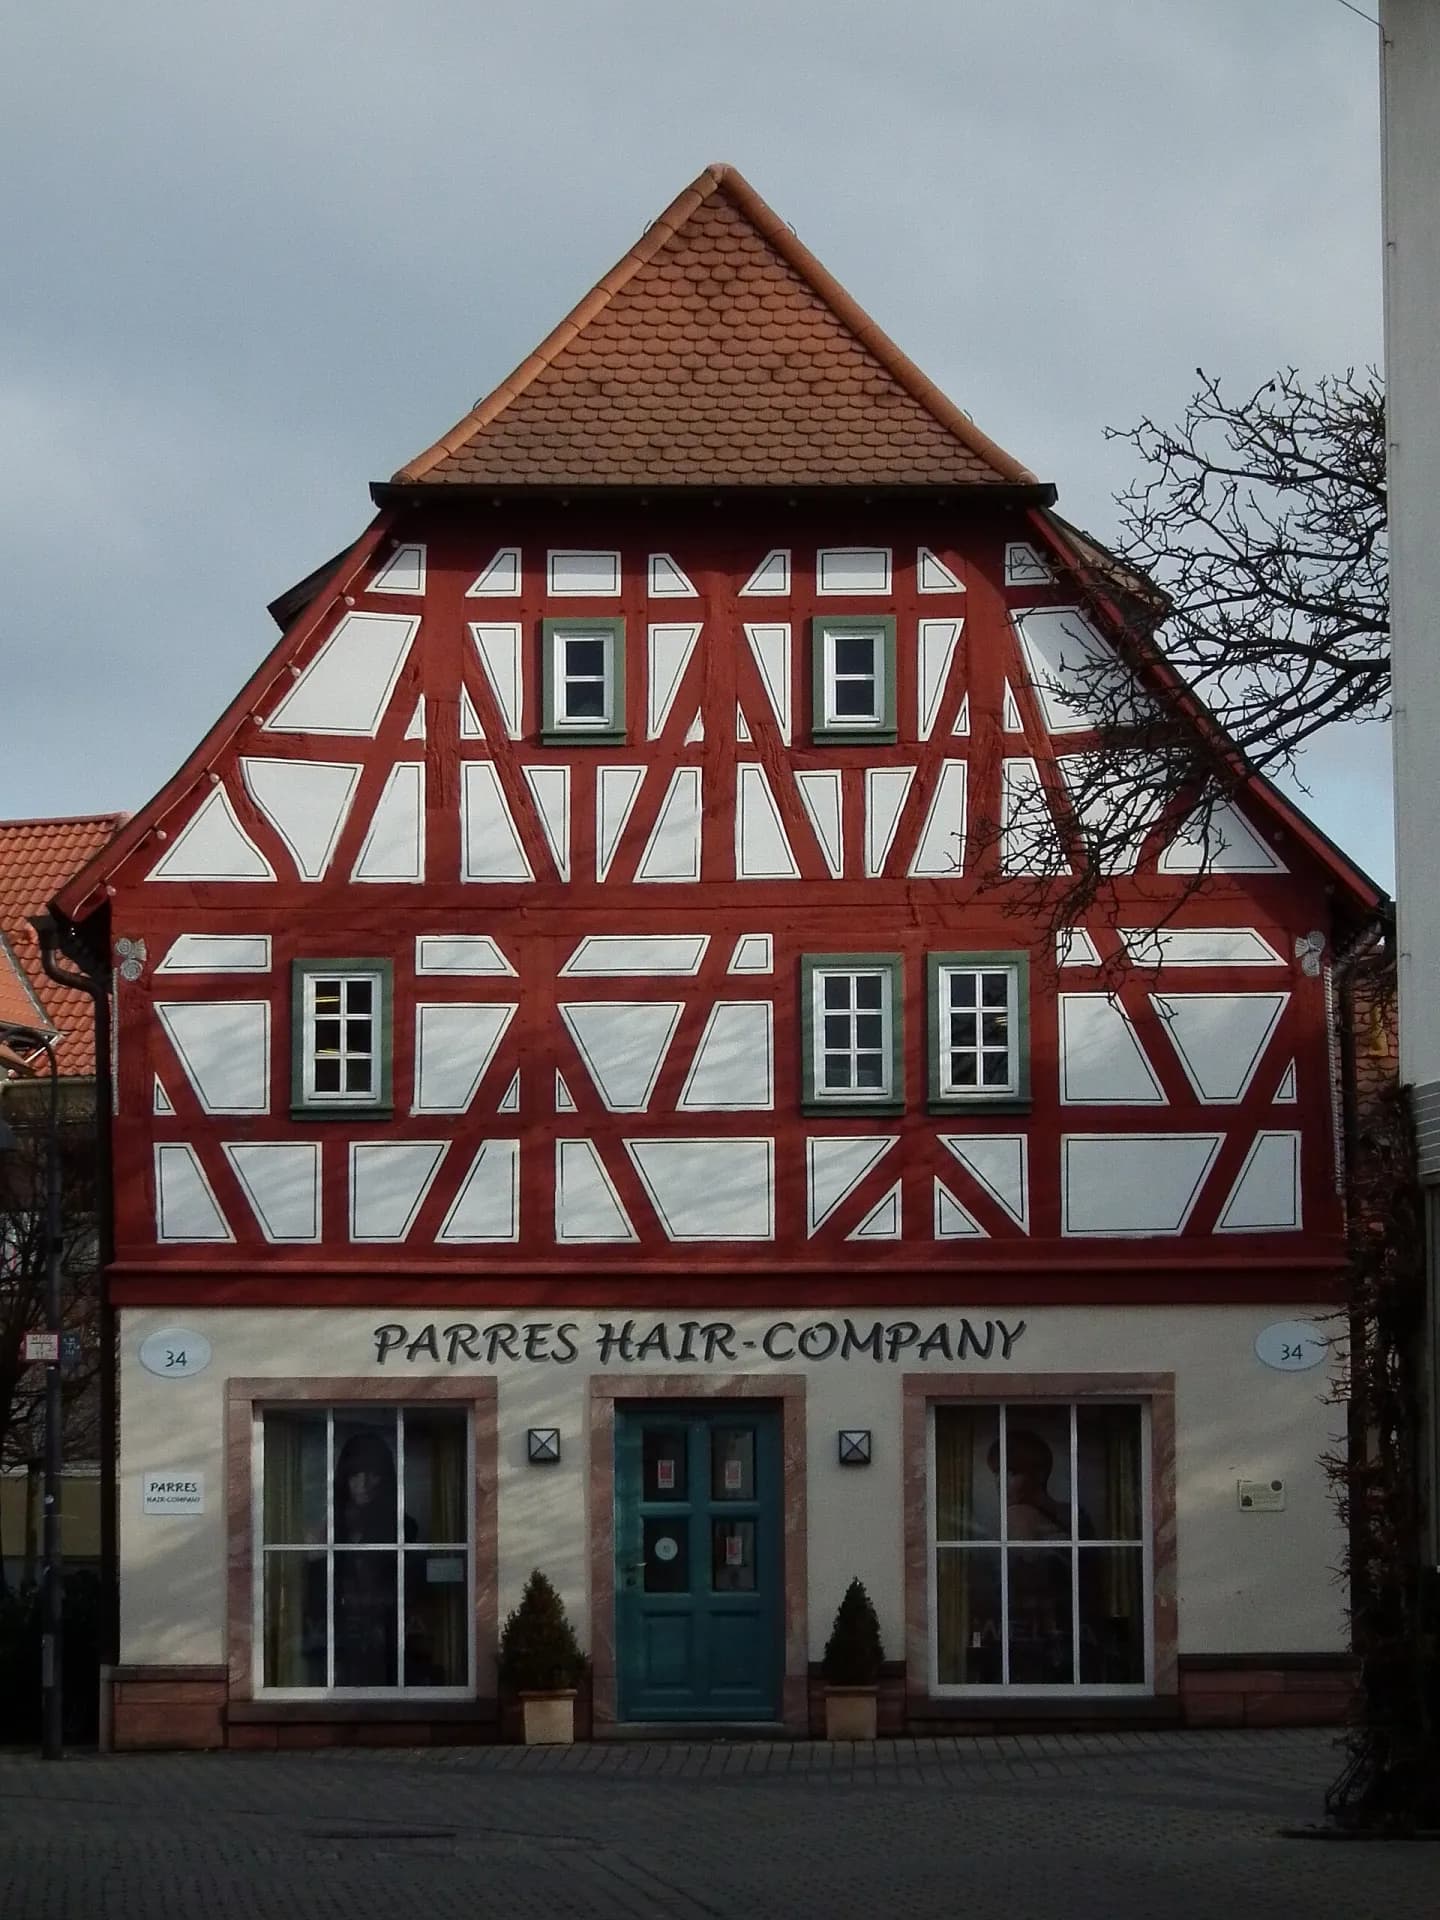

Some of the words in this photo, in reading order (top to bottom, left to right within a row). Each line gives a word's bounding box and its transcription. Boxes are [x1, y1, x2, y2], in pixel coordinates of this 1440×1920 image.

[373, 1322, 579, 1364] PARRES
[596, 1318, 1027, 1364] HAIR-COMPANY
[165, 1350, 187, 1367] 34
[1281, 1343, 1304, 1361] 34
[150, 1482, 198, 1492] PARRES
